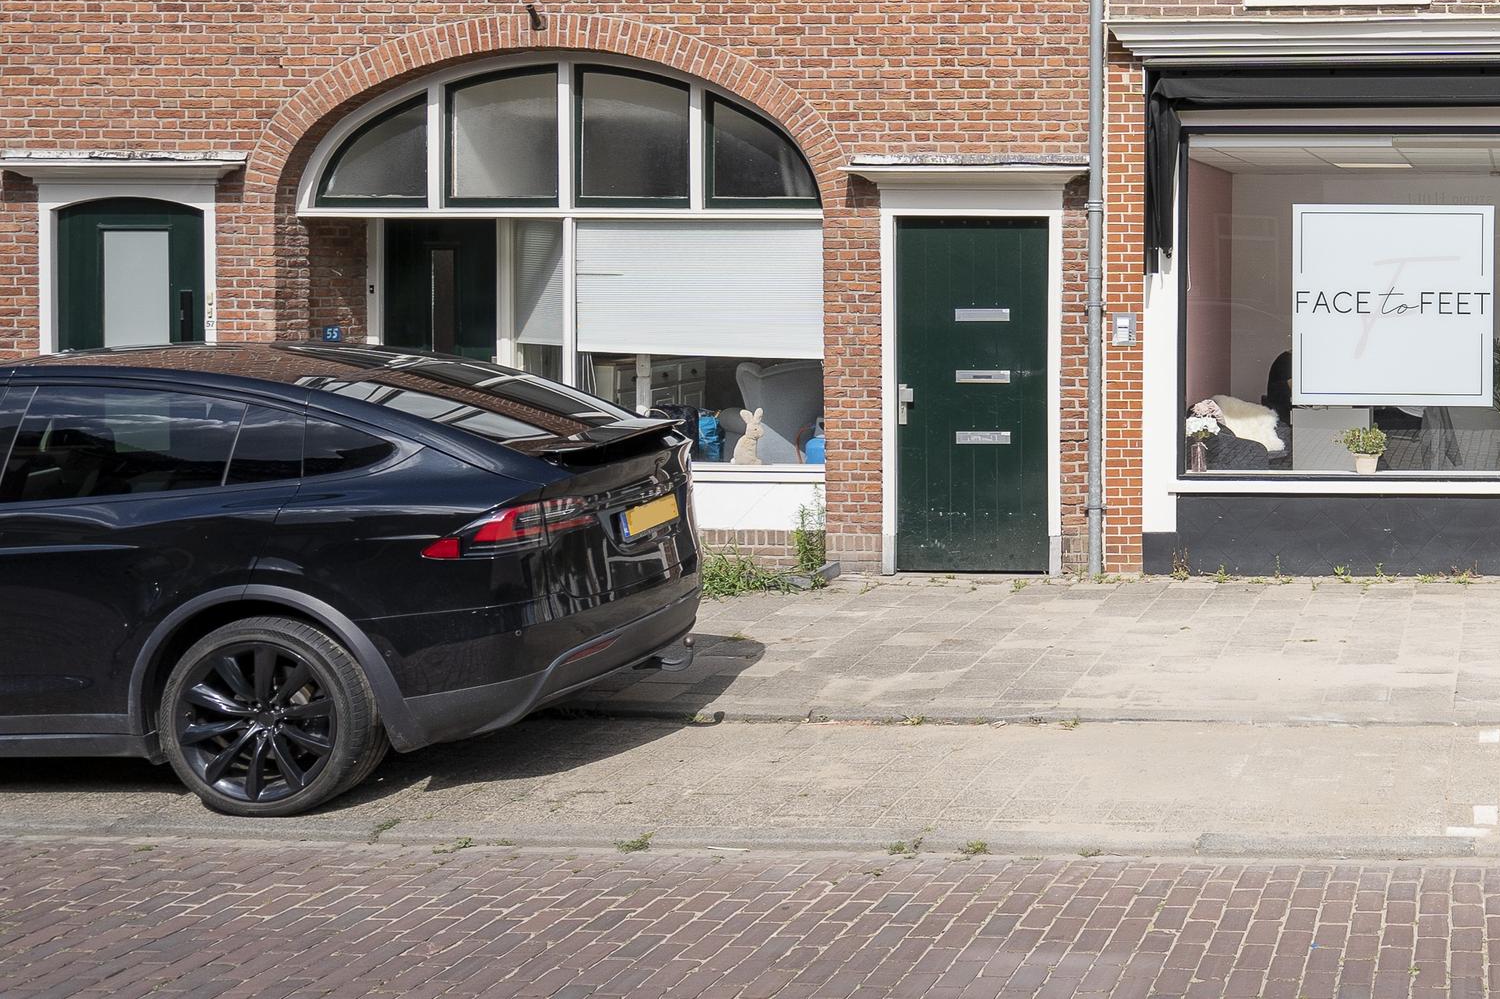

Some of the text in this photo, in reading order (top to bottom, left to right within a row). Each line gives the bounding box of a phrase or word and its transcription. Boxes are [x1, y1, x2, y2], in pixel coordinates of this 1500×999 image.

[1296, 286, 1491, 315] FACE to FEET
[326, 328, 339, 339] 55
